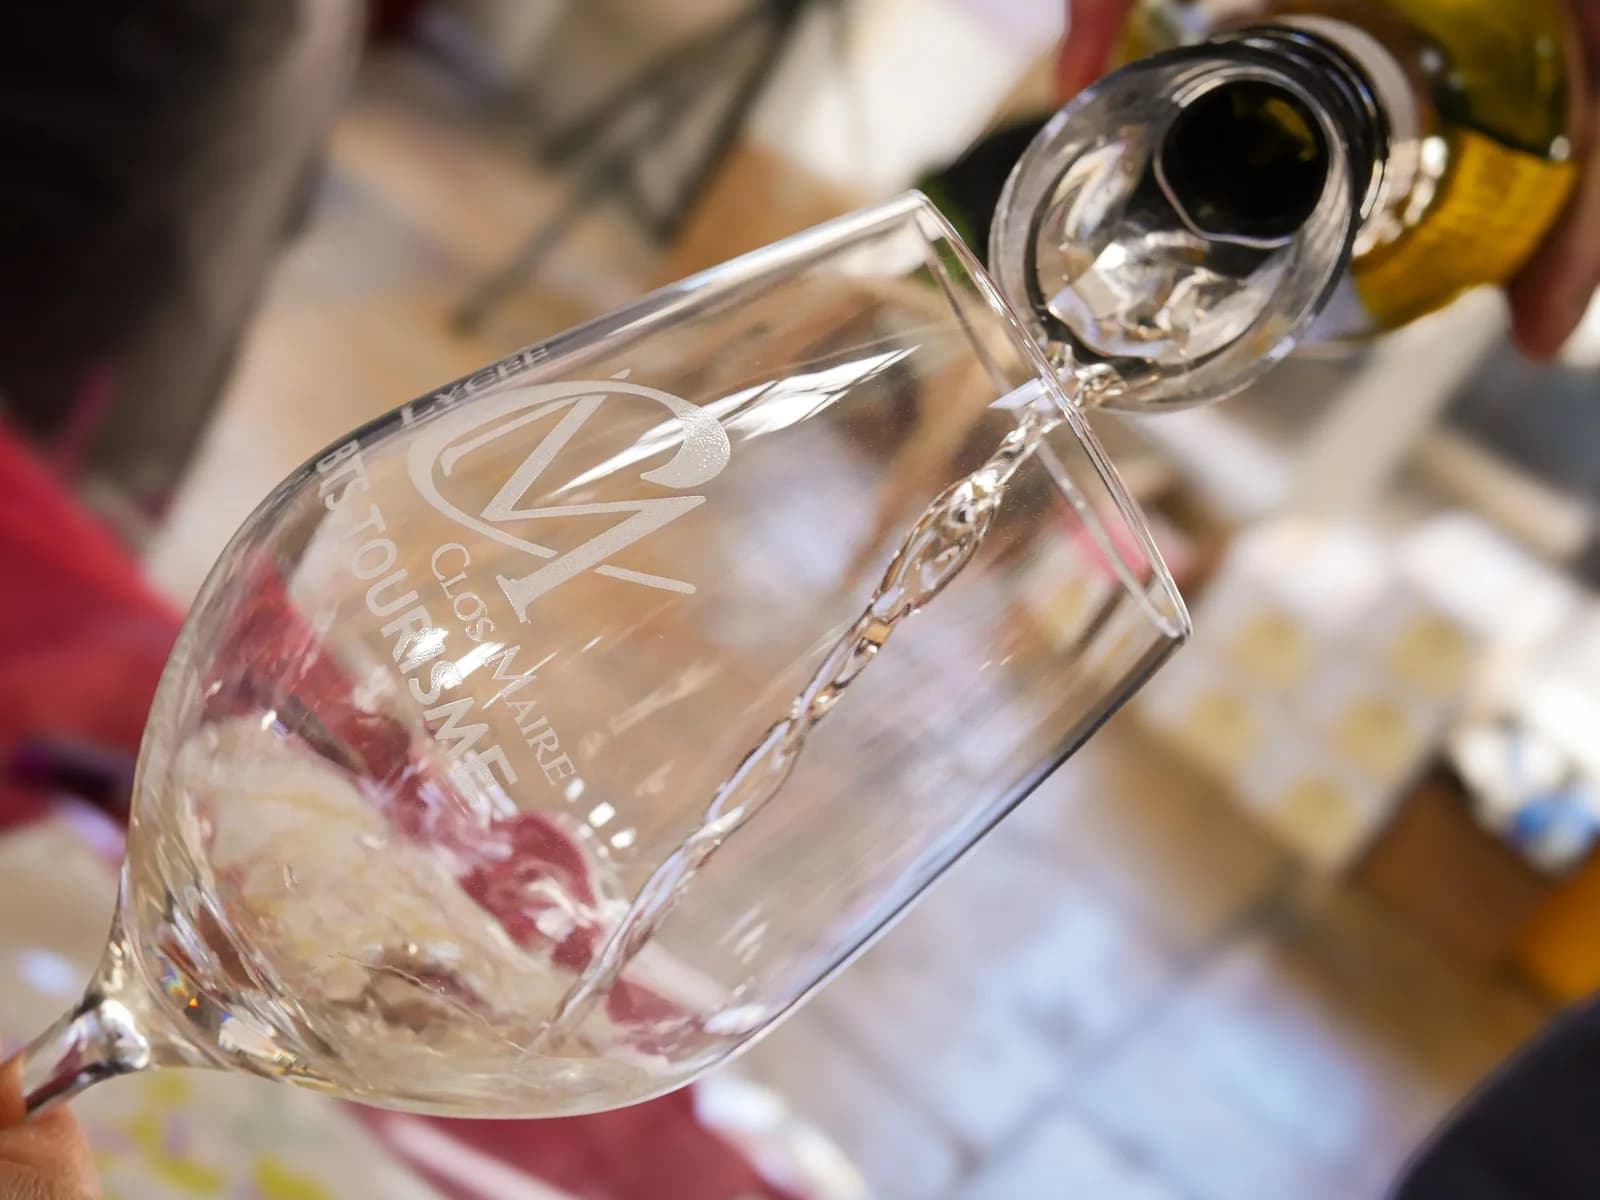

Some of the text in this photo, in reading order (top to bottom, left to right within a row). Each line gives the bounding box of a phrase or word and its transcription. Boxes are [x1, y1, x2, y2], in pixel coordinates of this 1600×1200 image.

[316, 439, 519, 812] BTS TOURISME
[432, 543, 577, 785] CLOS MAIRE
